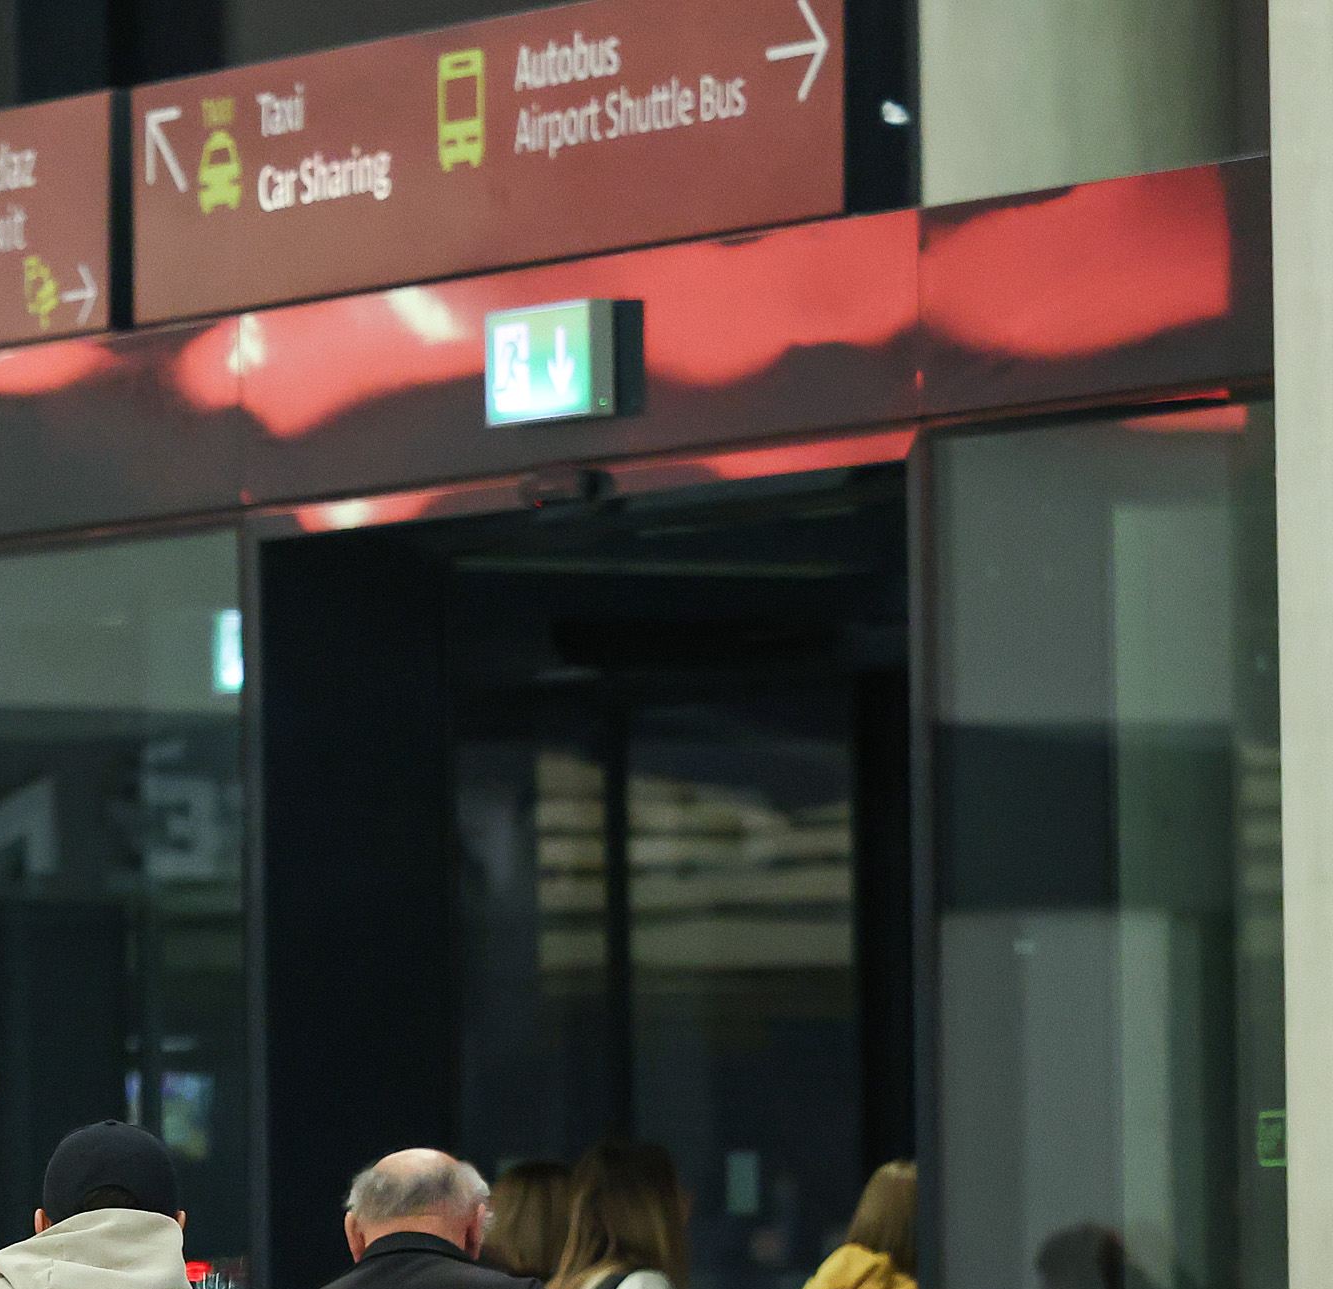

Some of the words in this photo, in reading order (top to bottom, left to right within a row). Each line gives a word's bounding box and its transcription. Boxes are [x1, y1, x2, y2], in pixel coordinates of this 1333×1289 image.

[514, 31, 621, 92] Autobus
[256, 82, 304, 137] Taxi
[514, 97, 602, 160] Airport
[605, 75, 695, 139] Shuttle
[700, 74, 747, 122] Bus
[257, 165, 298, 212] Car
[300, 144, 392, 204] Sharing
